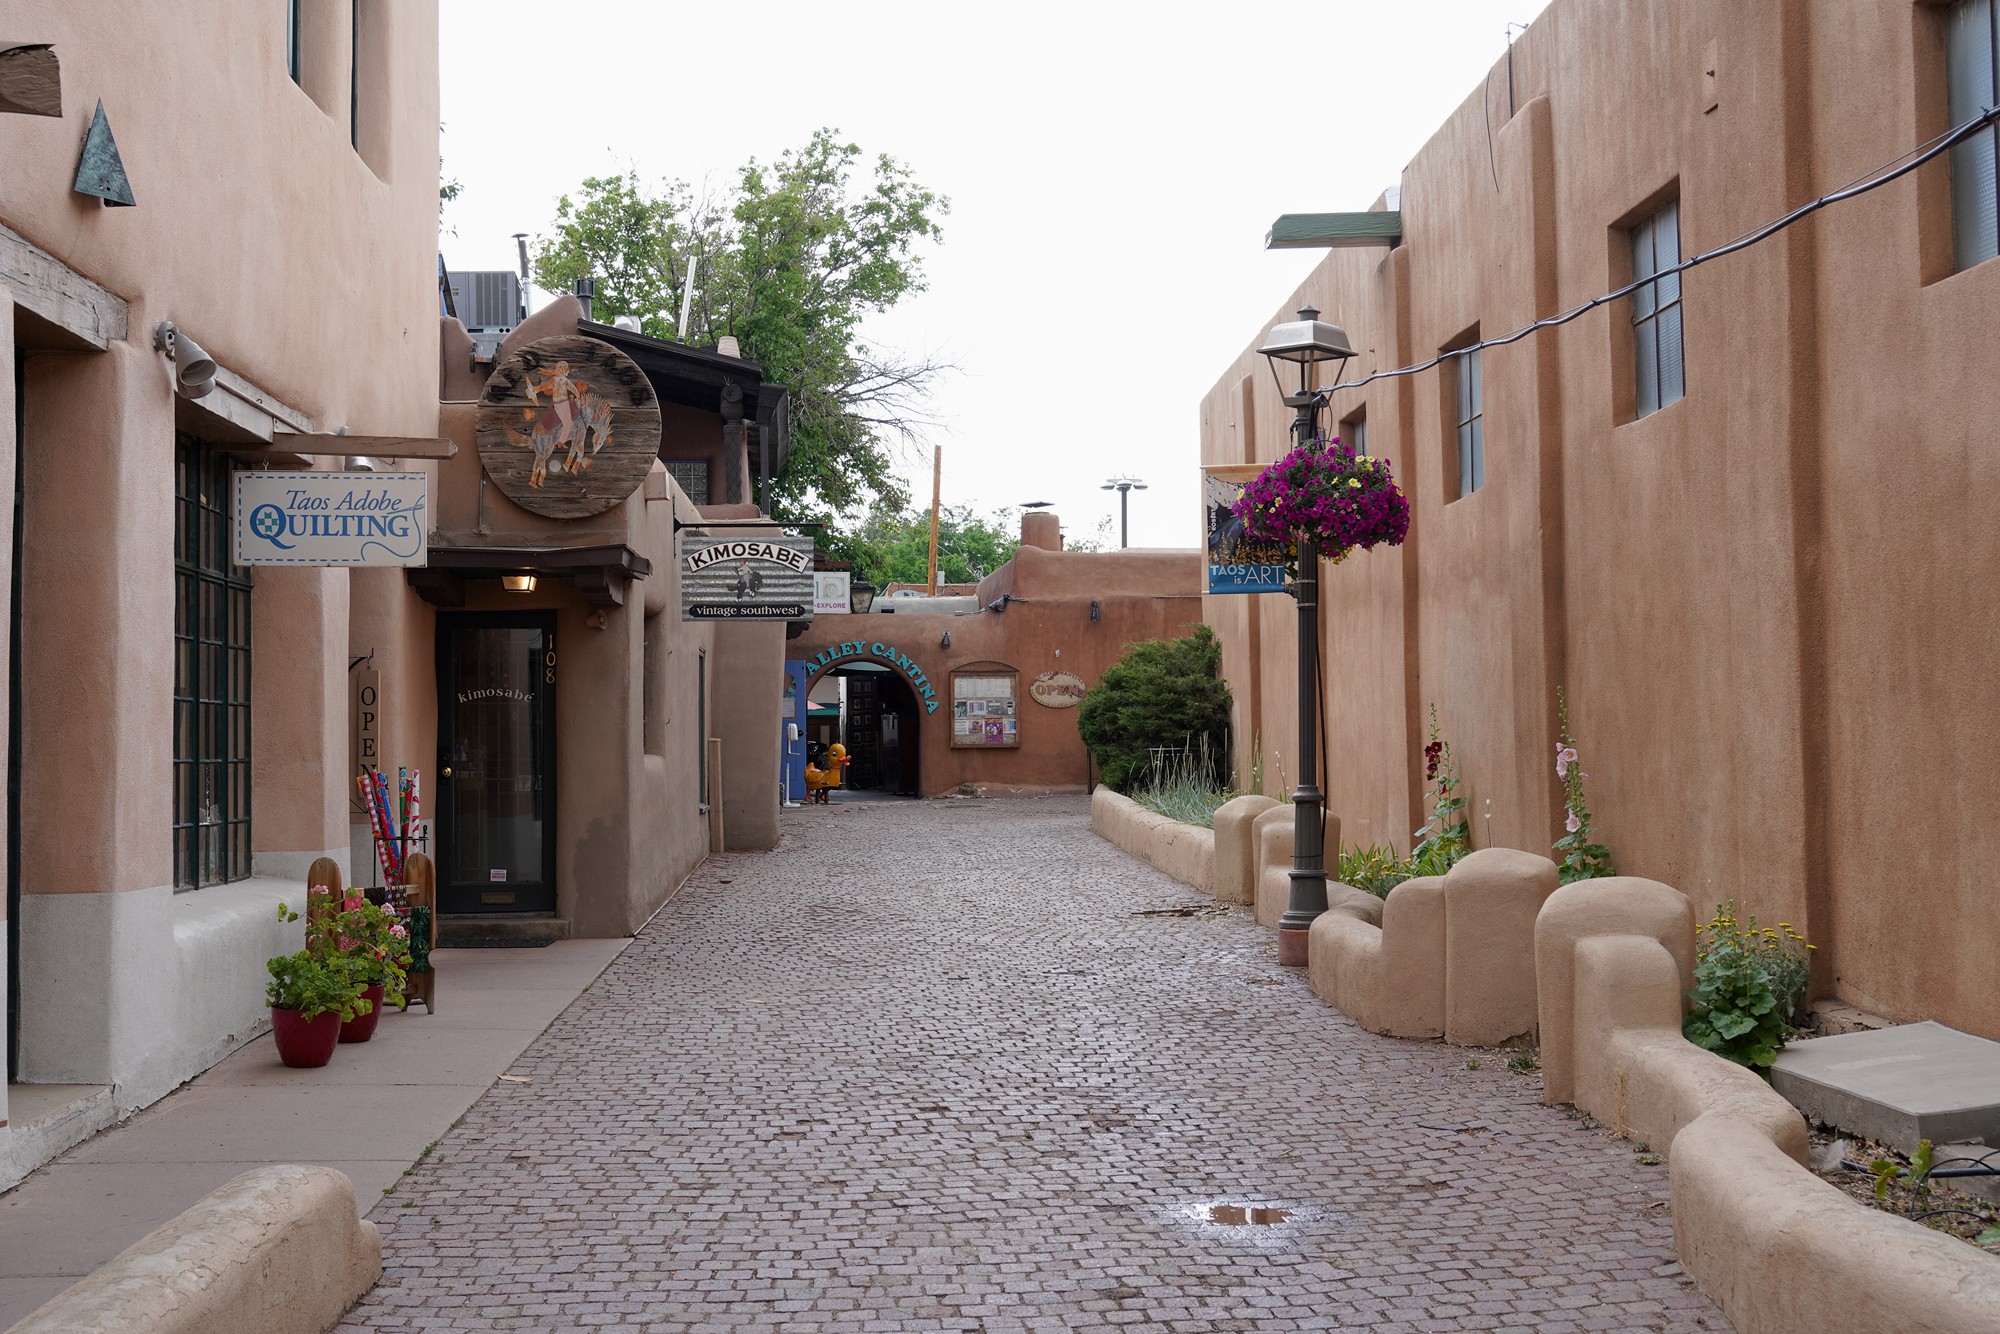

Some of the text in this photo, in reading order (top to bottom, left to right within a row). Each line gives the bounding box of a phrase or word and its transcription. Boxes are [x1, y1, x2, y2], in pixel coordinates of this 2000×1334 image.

[286, 489, 402, 511] Taos Adobe
[249, 503, 410, 550] QUILTING
[691, 542, 805, 570] KIMOSABE
[1210, 564, 1284, 585] TAOS is ART
[696, 606, 799, 617] vintage southwest
[546, 634, 556, 684] 108
[805, 640, 940, 715] ALLEY CANTINA
[1035, 684, 1080, 696] OPEN
